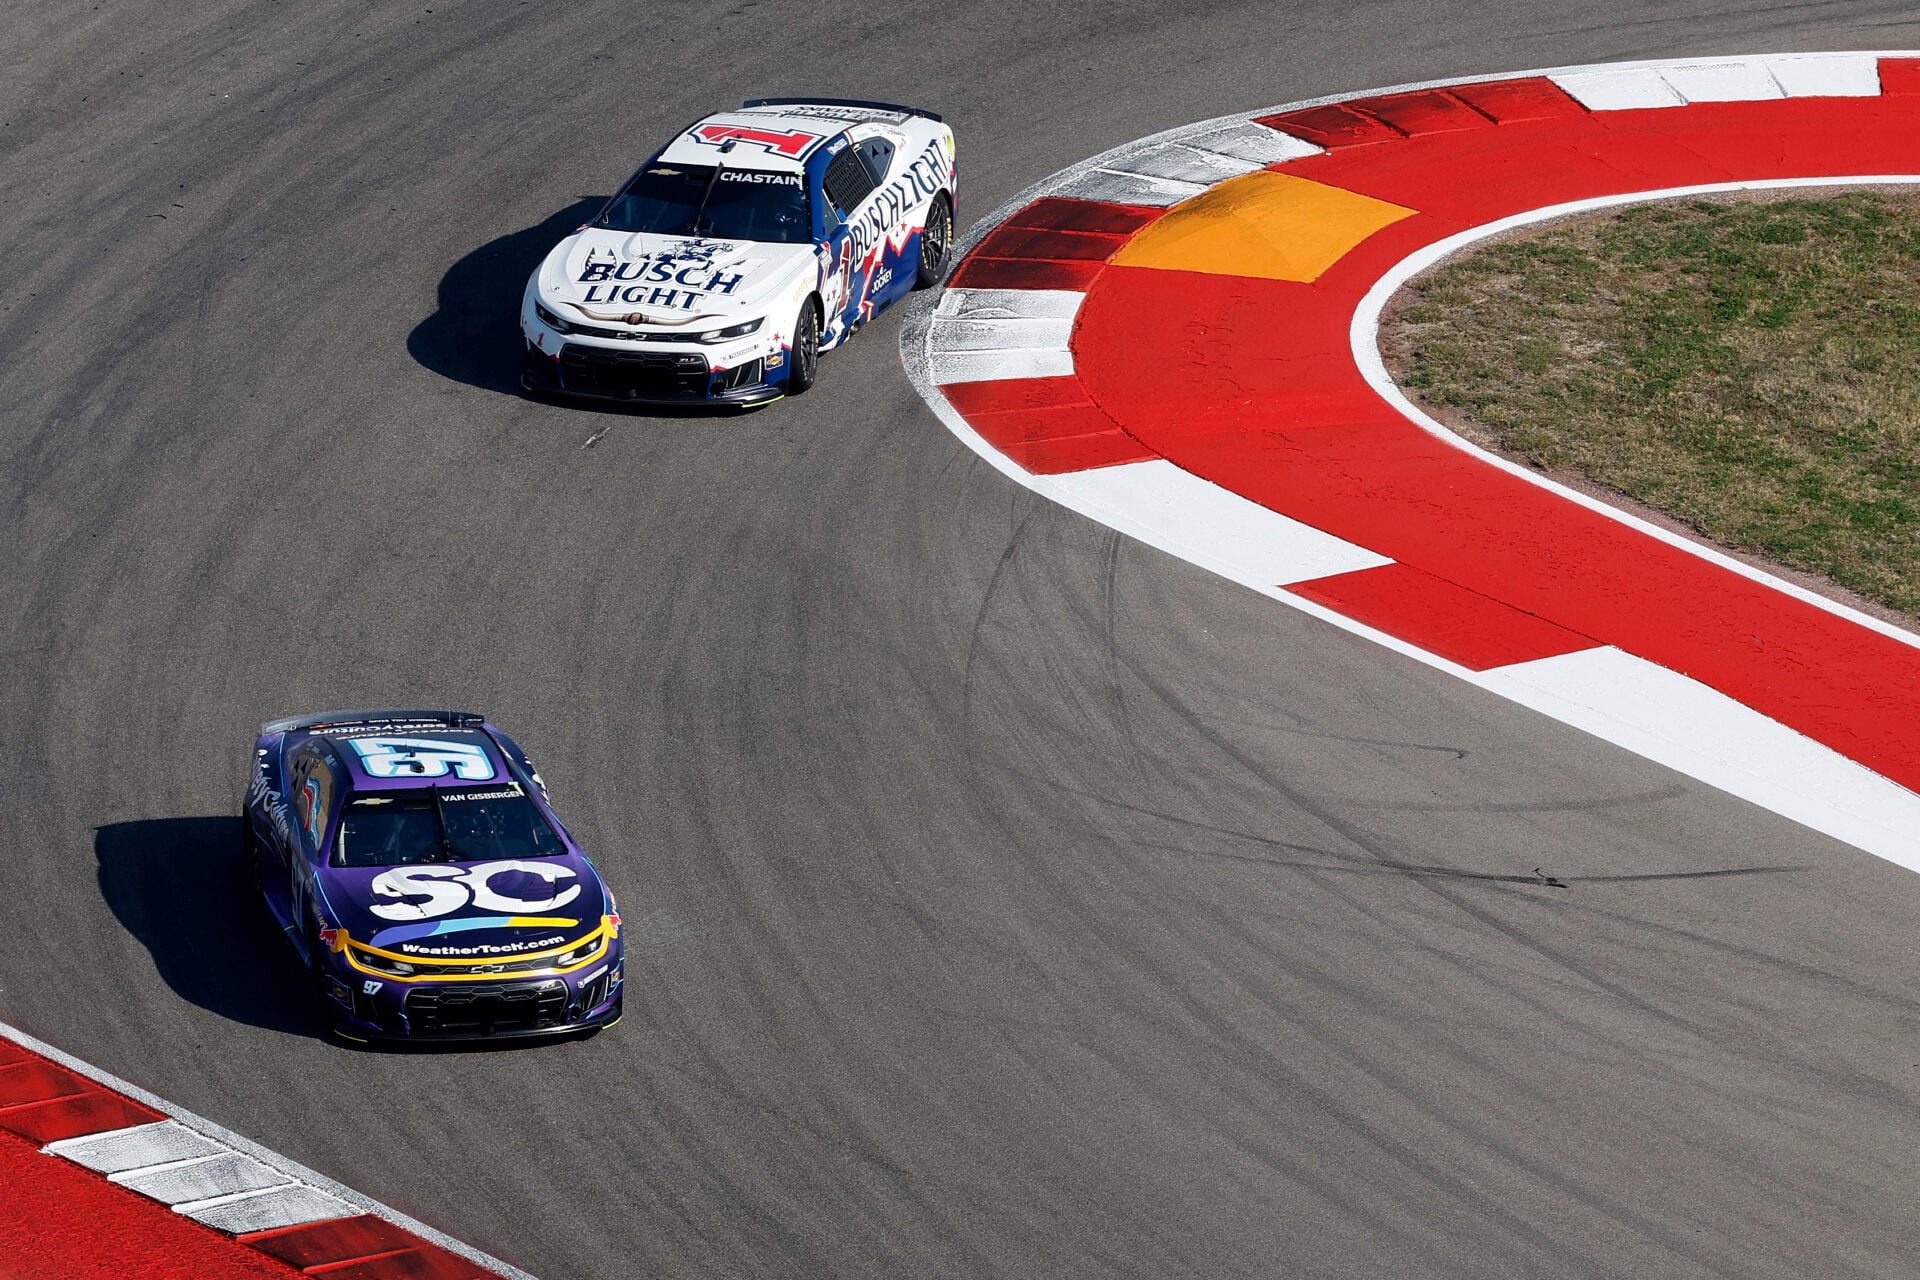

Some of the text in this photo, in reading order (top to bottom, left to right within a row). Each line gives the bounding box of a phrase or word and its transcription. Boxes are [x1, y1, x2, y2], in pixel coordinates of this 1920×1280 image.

[690, 124, 823, 158] 1
[720, 172, 801, 185] CHASTAIN
[851, 187, 899, 267] BUSCH
[892, 139, 948, 213] LIGHT
[578, 262, 744, 295] BUSCH
[871, 268, 893, 294] JOCKEY
[583, 285, 704, 310] LIGHT
[349, 738, 495, 781] 97
[442, 793, 465, 802] VAN
[369, 860, 581, 920] SC
[402, 936, 566, 955] WeatherTech.com
[363, 980, 383, 996] 97
